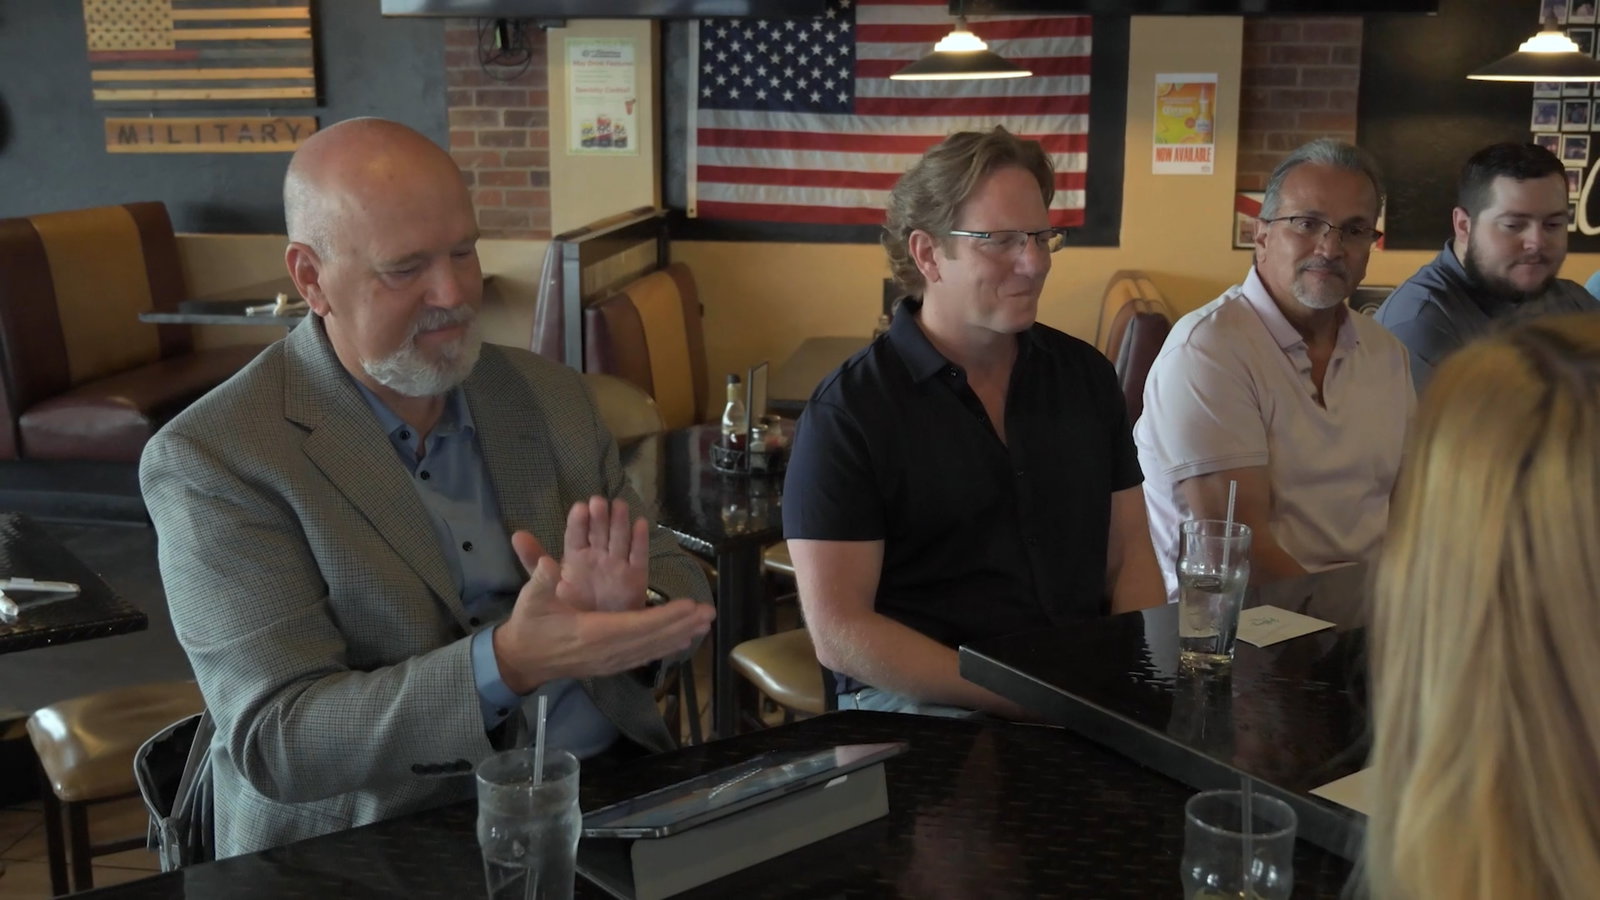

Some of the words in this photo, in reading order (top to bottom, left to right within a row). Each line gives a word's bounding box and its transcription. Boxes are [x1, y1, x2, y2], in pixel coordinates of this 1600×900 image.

[118, 124, 302, 144] MILITARY
[1156, 147, 1173, 162] NOW
[1174, 147, 1212, 162] AVAILABLE
